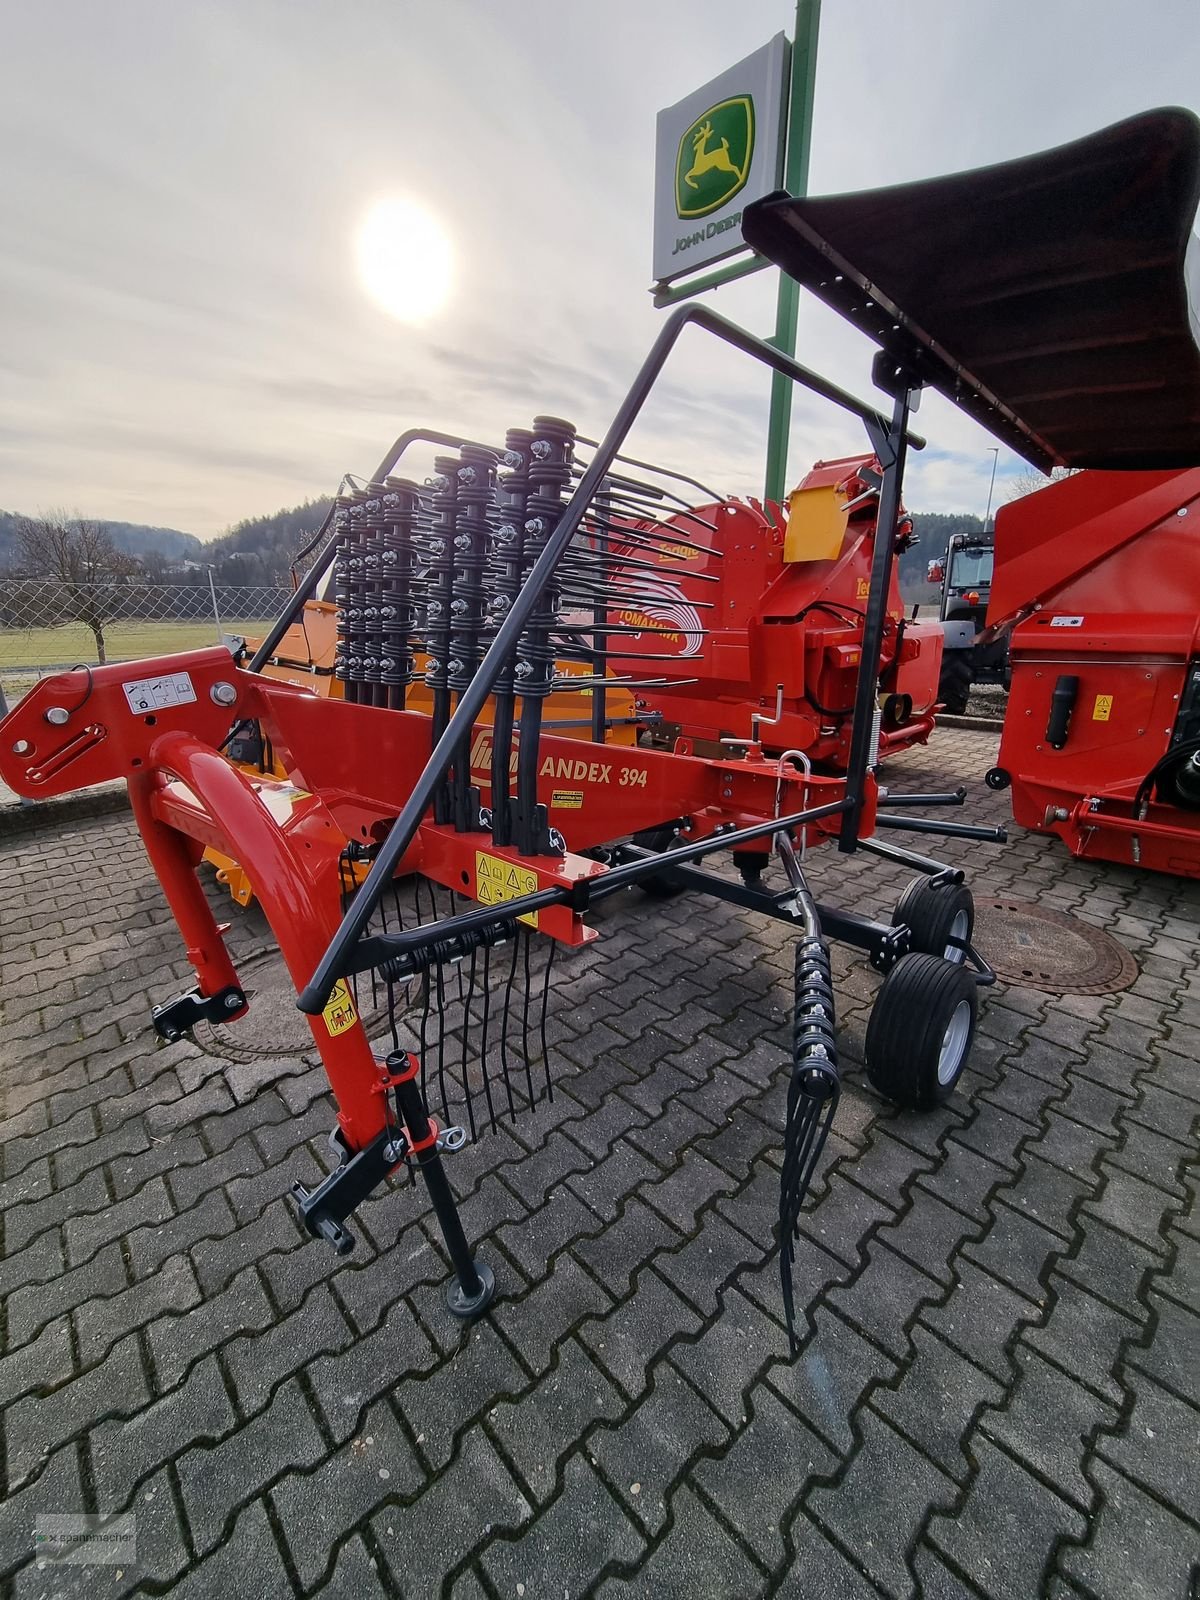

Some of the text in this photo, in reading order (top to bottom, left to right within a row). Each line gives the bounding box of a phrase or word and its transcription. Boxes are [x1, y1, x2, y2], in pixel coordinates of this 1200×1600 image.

[672, 212, 742, 255] JOHN DEER
[539, 756, 612, 784] ANDEX
[618, 767, 648, 788] 394
